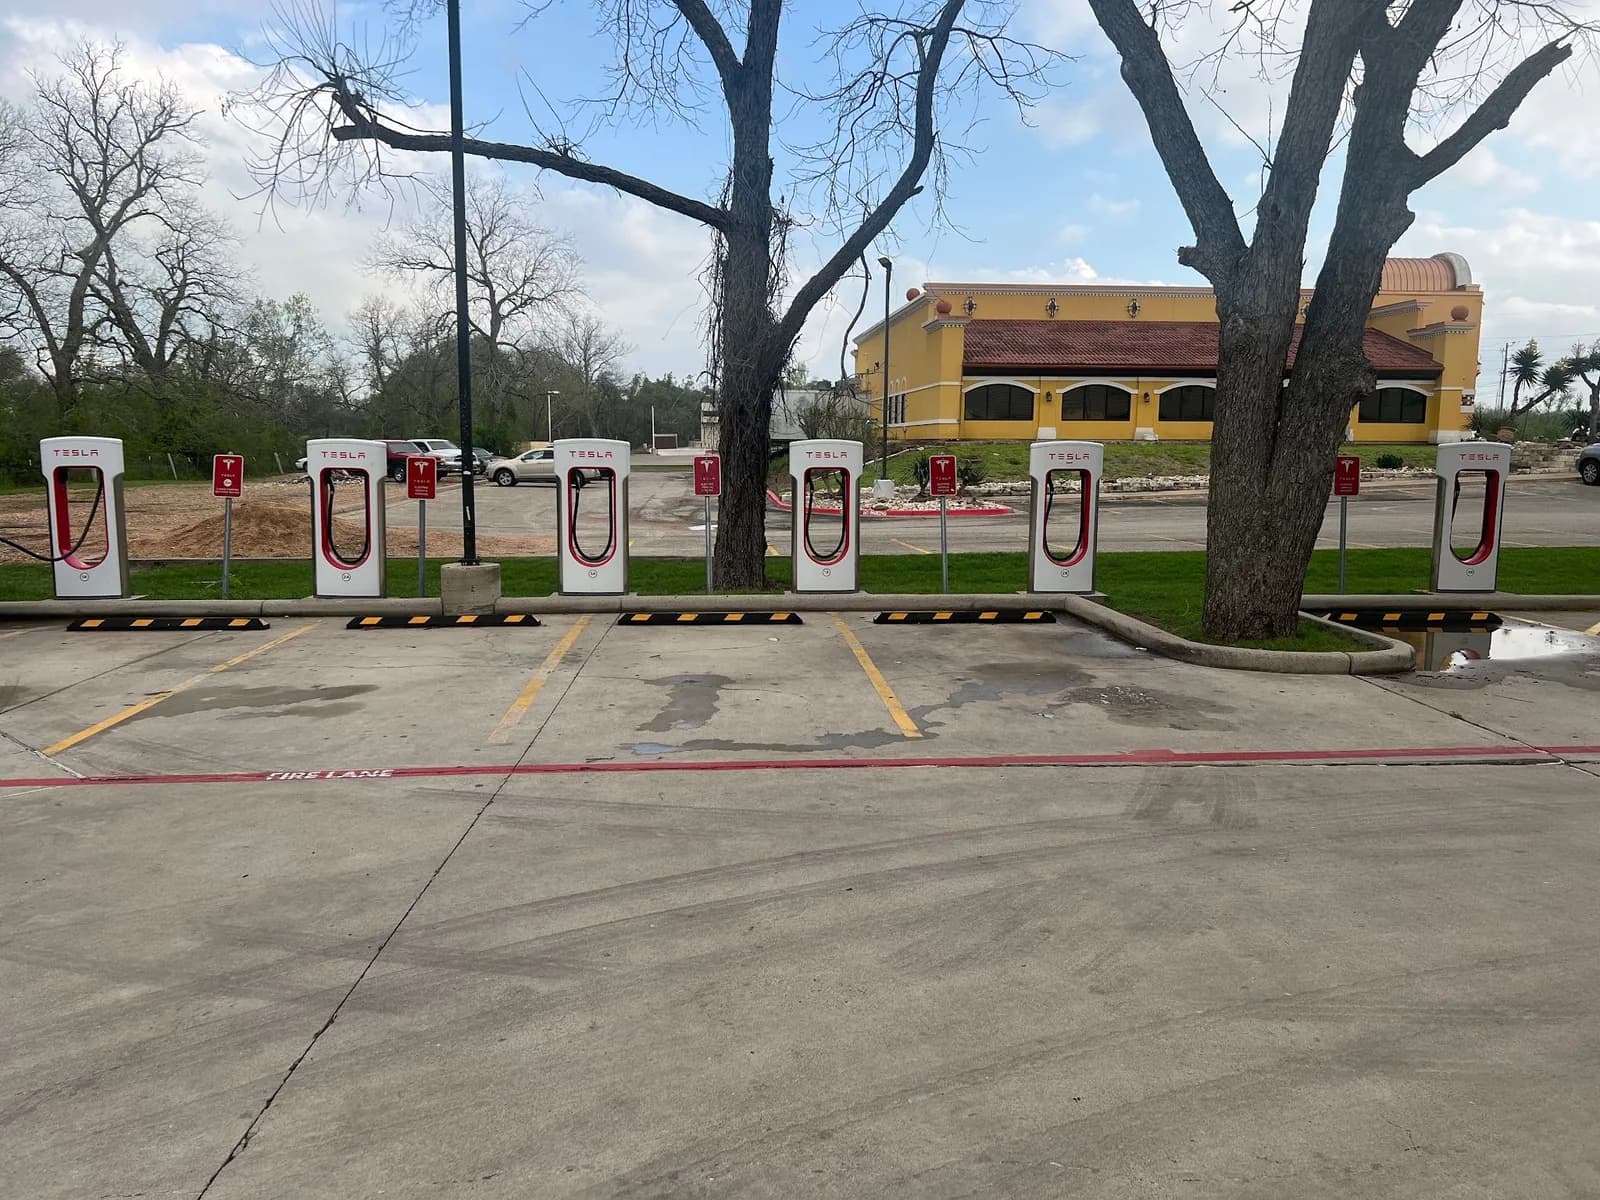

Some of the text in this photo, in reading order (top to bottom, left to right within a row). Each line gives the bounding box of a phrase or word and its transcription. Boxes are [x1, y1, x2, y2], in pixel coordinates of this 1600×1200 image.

[53, 449, 99, 457] TESLA
[321, 450, 366, 459] TESLA
[569, 450, 613, 458] TESLA
[806, 451, 848, 459] TESLA
[1459, 453, 1500, 461] TESLA
[266, 769, 394, 780] FIRE LANE
